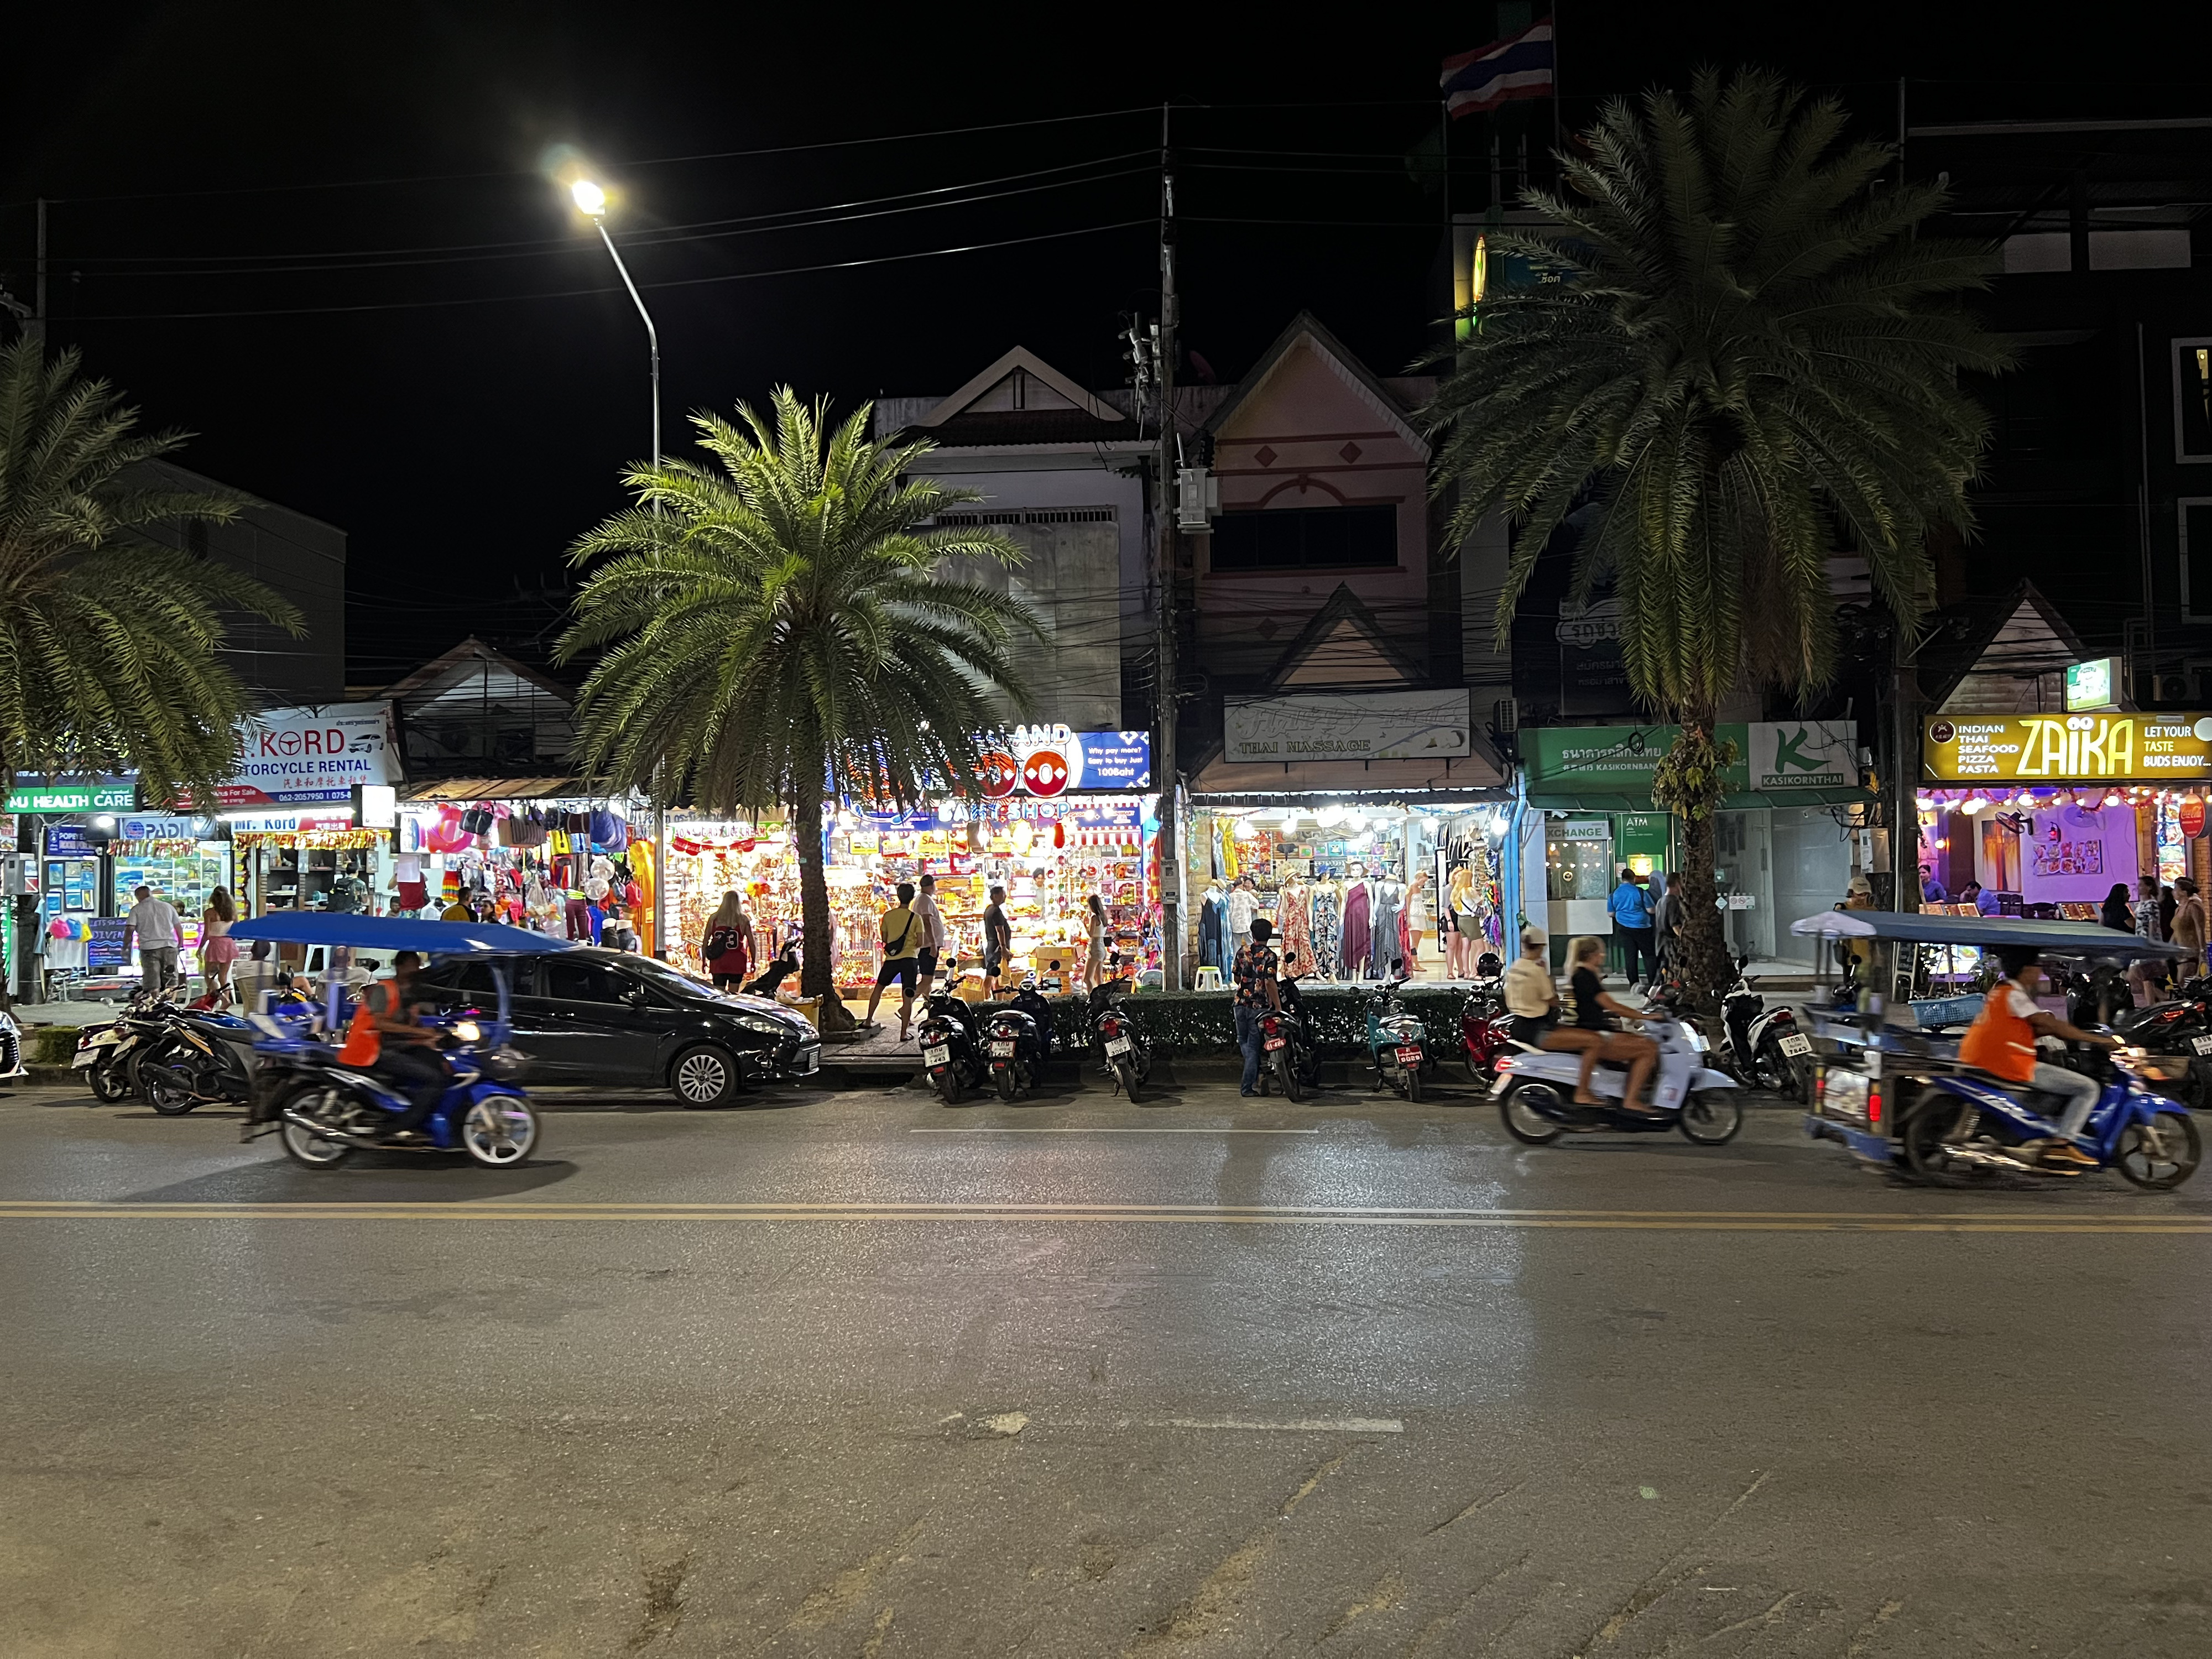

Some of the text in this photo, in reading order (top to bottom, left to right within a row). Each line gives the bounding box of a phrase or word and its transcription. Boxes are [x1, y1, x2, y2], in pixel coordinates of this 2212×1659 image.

[1959, 725, 2004, 734] INDIAN
[2145, 726, 2191, 737] LET YOUR
[1958, 735, 1988, 743] THAI
[1239, 740, 1370, 753] THAI MASSAGE
[1958, 745, 2018, 753] SEAFOOD
[2143, 741, 2174, 752] TASTE
[319, 759, 371, 772] RENTAL
[2143, 755, 2211, 767] BUDS ENJOY...
[1958, 765, 1999, 773] PASTA
[1763, 775, 1842, 785] KASIKORNTHAI
[33, 795, 89, 808] HEALTH
[94, 795, 133, 807] CARE
[279, 792, 324, 801] 062-2057950
[1007, 802, 1071, 820] SHOP
[1626, 817, 1647, 826] ATM
[146, 823, 184, 838] PADI
[1547, 828, 1602, 837] XCHANGE
